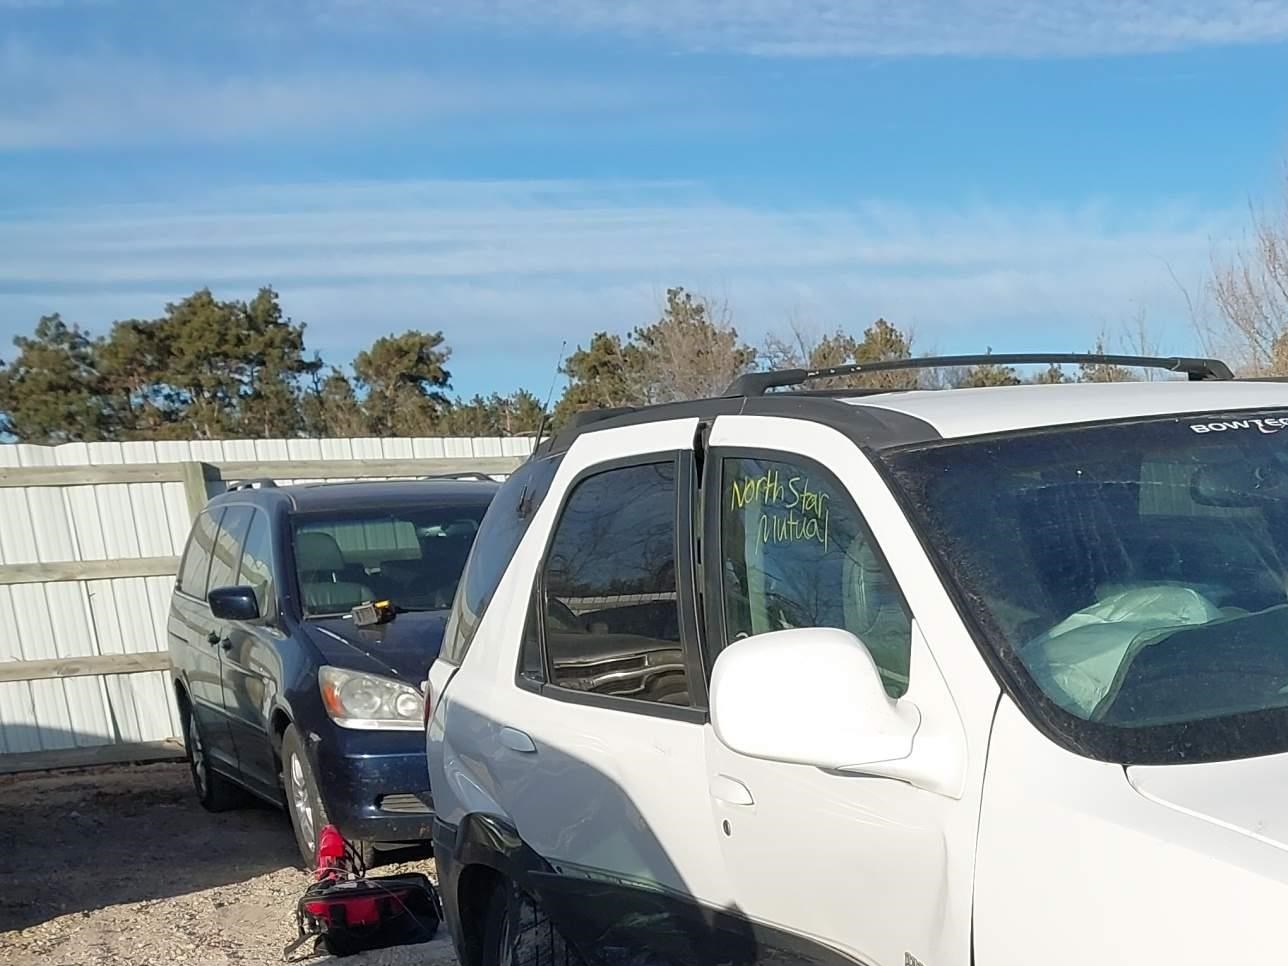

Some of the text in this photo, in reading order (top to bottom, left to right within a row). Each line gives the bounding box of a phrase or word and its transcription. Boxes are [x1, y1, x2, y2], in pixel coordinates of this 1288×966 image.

[730, 469, 830, 519] North Star
[755, 509, 829, 555] Mutual
